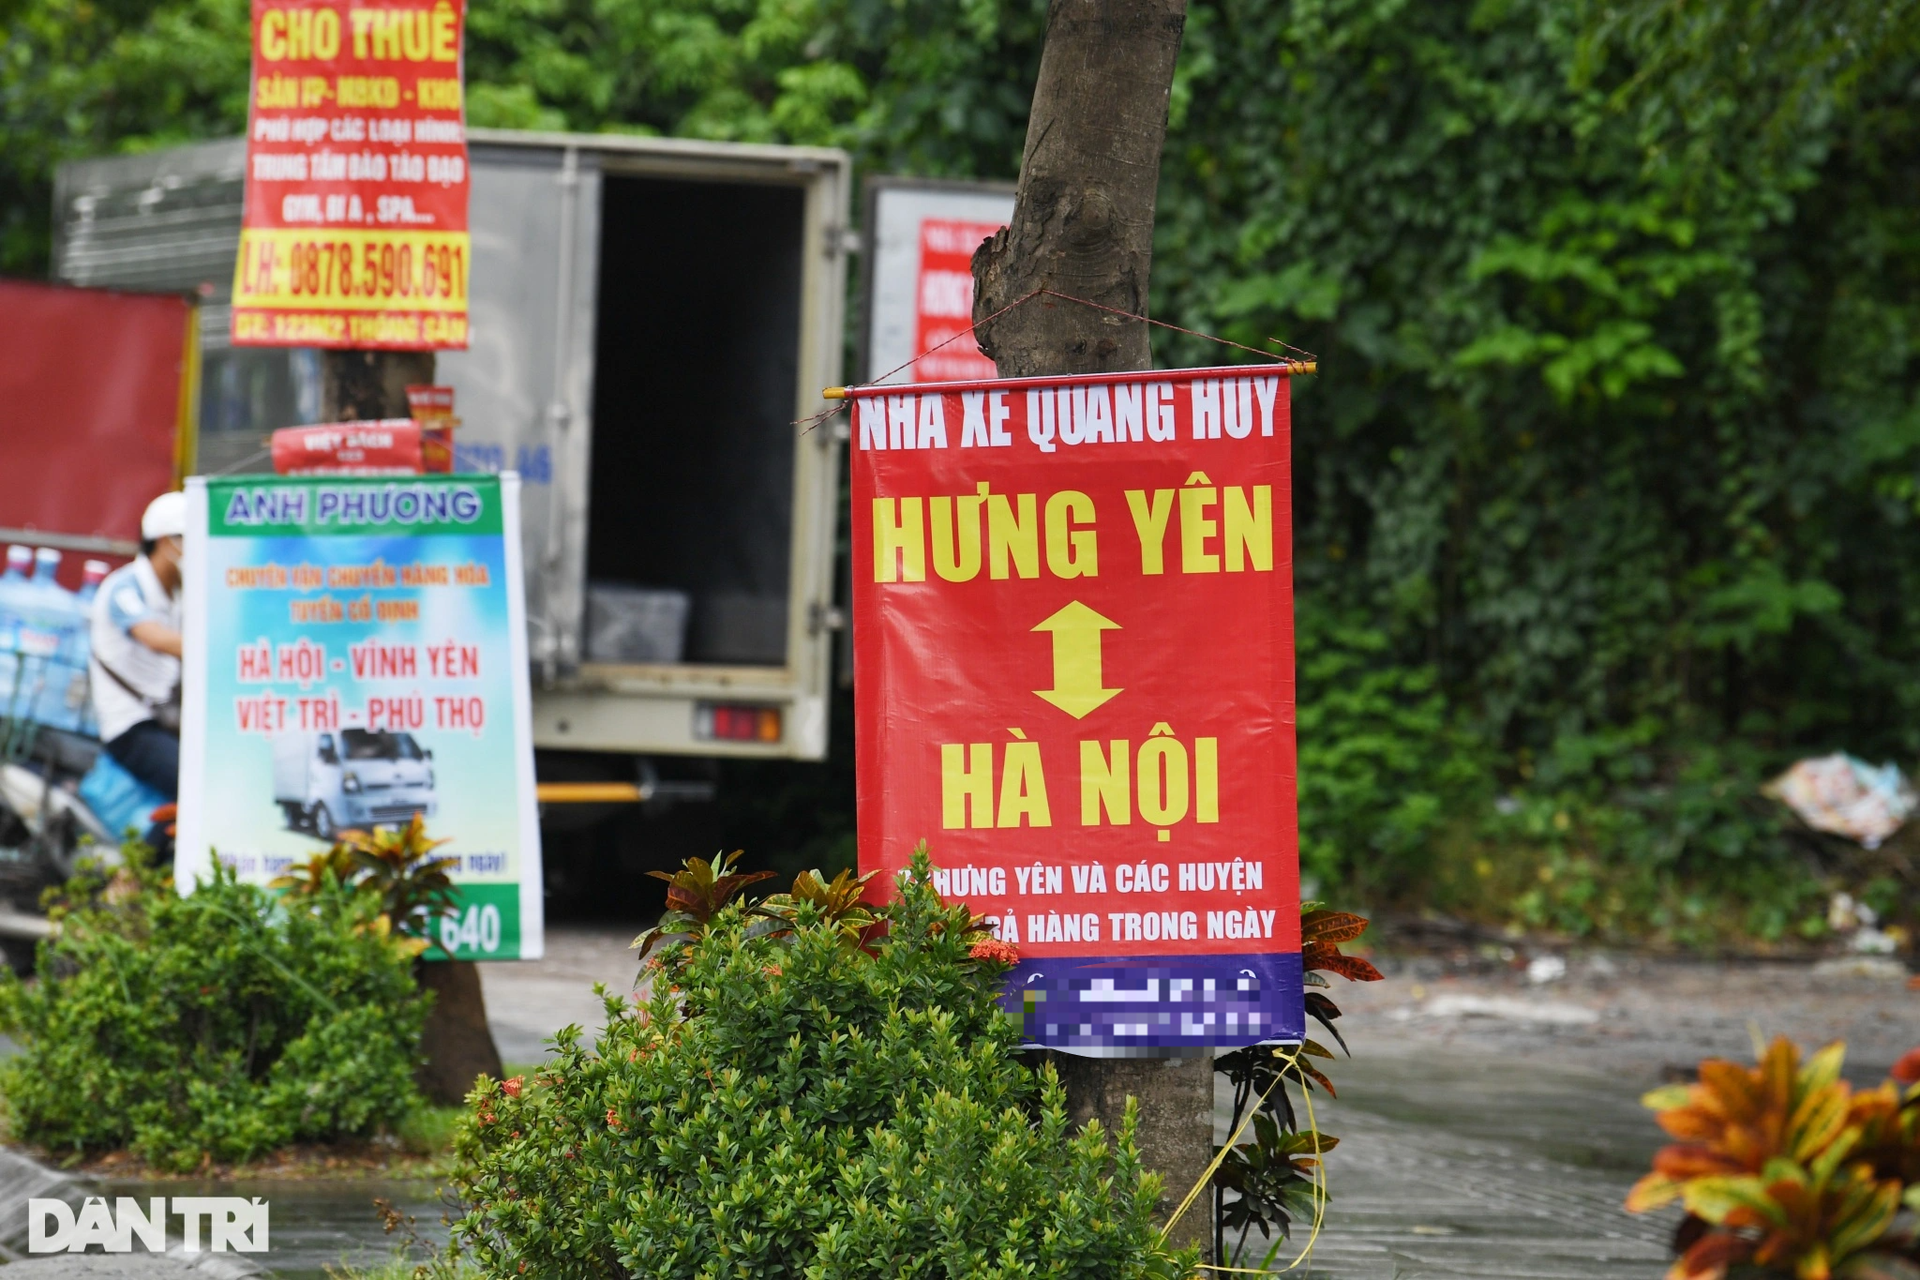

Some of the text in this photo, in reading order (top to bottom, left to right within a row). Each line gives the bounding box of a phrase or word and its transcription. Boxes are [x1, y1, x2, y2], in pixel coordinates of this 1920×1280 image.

[260, 1, 458, 62] CHO THUÊ
[291, 242, 464, 298] 0878.590.691
[961, 388, 1012, 448] XE
[1026, 379, 1176, 453] QUANG
[1191, 375, 1279, 440] HUY
[224, 482, 484, 526] ANH PHƯƠNG
[873, 471, 1273, 583] HƯNG YÊN
[425, 638, 480, 679] YÊN
[237, 692, 287, 737] VIỆT
[433, 697, 485, 737] THỌ
[941, 722, 1220, 842] HÀ NỘI
[933, 864, 1006, 897] HƯNG
[1015, 861, 1063, 895] YÊN
[1071, 860, 1107, 894] VÀ
[1115, 860, 1169, 893] CÁC
[1178, 857, 1263, 896] HUYỆN
[1028, 906, 1100, 942] HÀNG
[1108, 911, 1198, 941] TRONG
[1207, 906, 1276, 940] NGÀY
